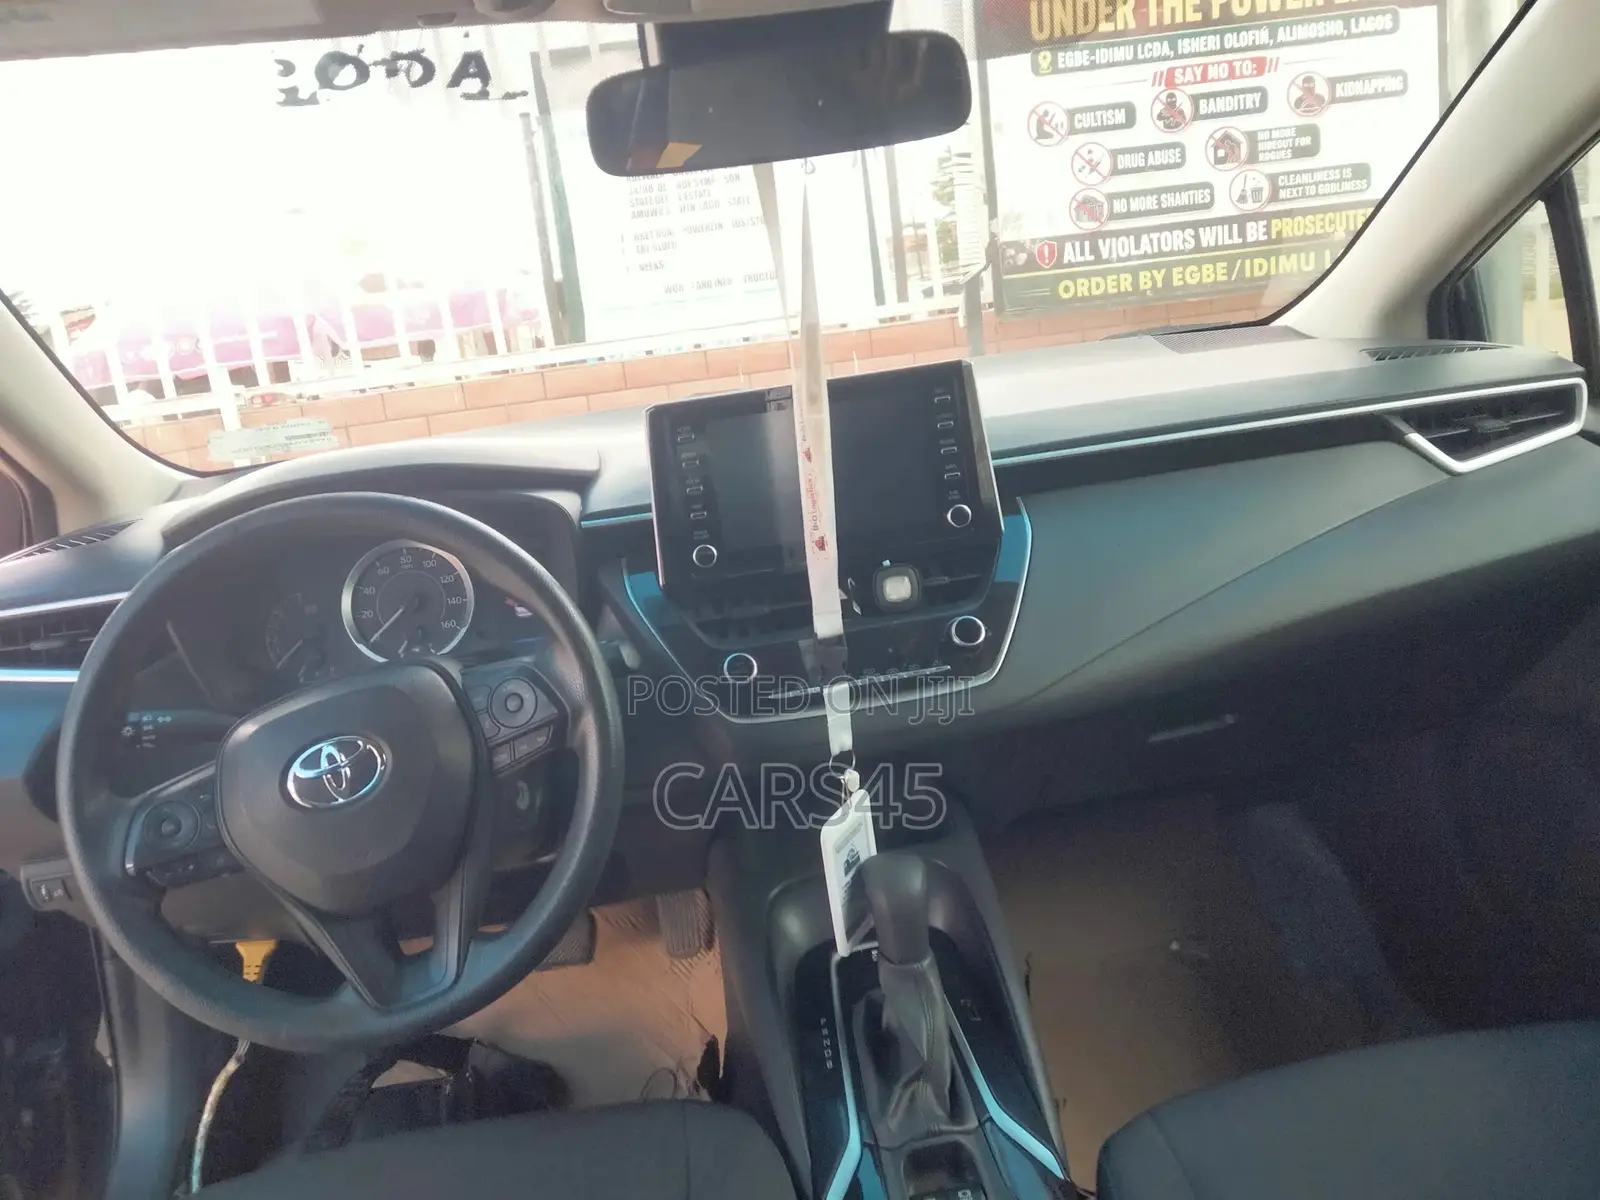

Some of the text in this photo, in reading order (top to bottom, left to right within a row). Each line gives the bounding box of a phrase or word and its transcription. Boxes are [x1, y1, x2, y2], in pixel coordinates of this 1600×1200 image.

[1029, 0, 1136, 41] UNDER
[1057, 45, 1134, 69] EGBE-IDIMU
[1137, 43, 1174, 60] LCDA,
[1177, 33, 1220, 54] ISHERI
[1277, 20, 1347, 43] ALIMOSHO,
[1351, 13, 1394, 34] LAGOS
[1174, 60, 1257, 84] SAY NO TO:
[1335, 76, 1404, 97] KIDNAPPING
[1200, 92, 1262, 114] BANDITRY
[1074, 108, 1126, 129] CULTISM
[1258, 127, 1296, 140] NO MORE
[1295, 136, 1312, 147] FOR
[1117, 148, 1182, 170] DRUG ABUSE
[1259, 149, 1292, 161] ROGUES
[1278, 167, 1352, 186] CLEANLINESS IS
[1279, 179, 1368, 200] NEXT TO GODLINESS
[1113, 189, 1211, 214] NO MORE SHANTIES
[1063, 207, 1375, 264] ALL VIOLATORS WILL BE PROSECUTE
[1058, 273, 1132, 299] ORDER
[1139, 268, 1167, 290] BY
[400, 555, 412, 564] 80
[422, 560, 437, 568] 100
[377, 566, 390, 575] 60
[440, 574, 454, 583] 120
[363, 586, 376, 595] 40
[447, 596, 462, 605] 140
[361, 609, 374, 619] 20
[440, 620, 456, 629] 160
